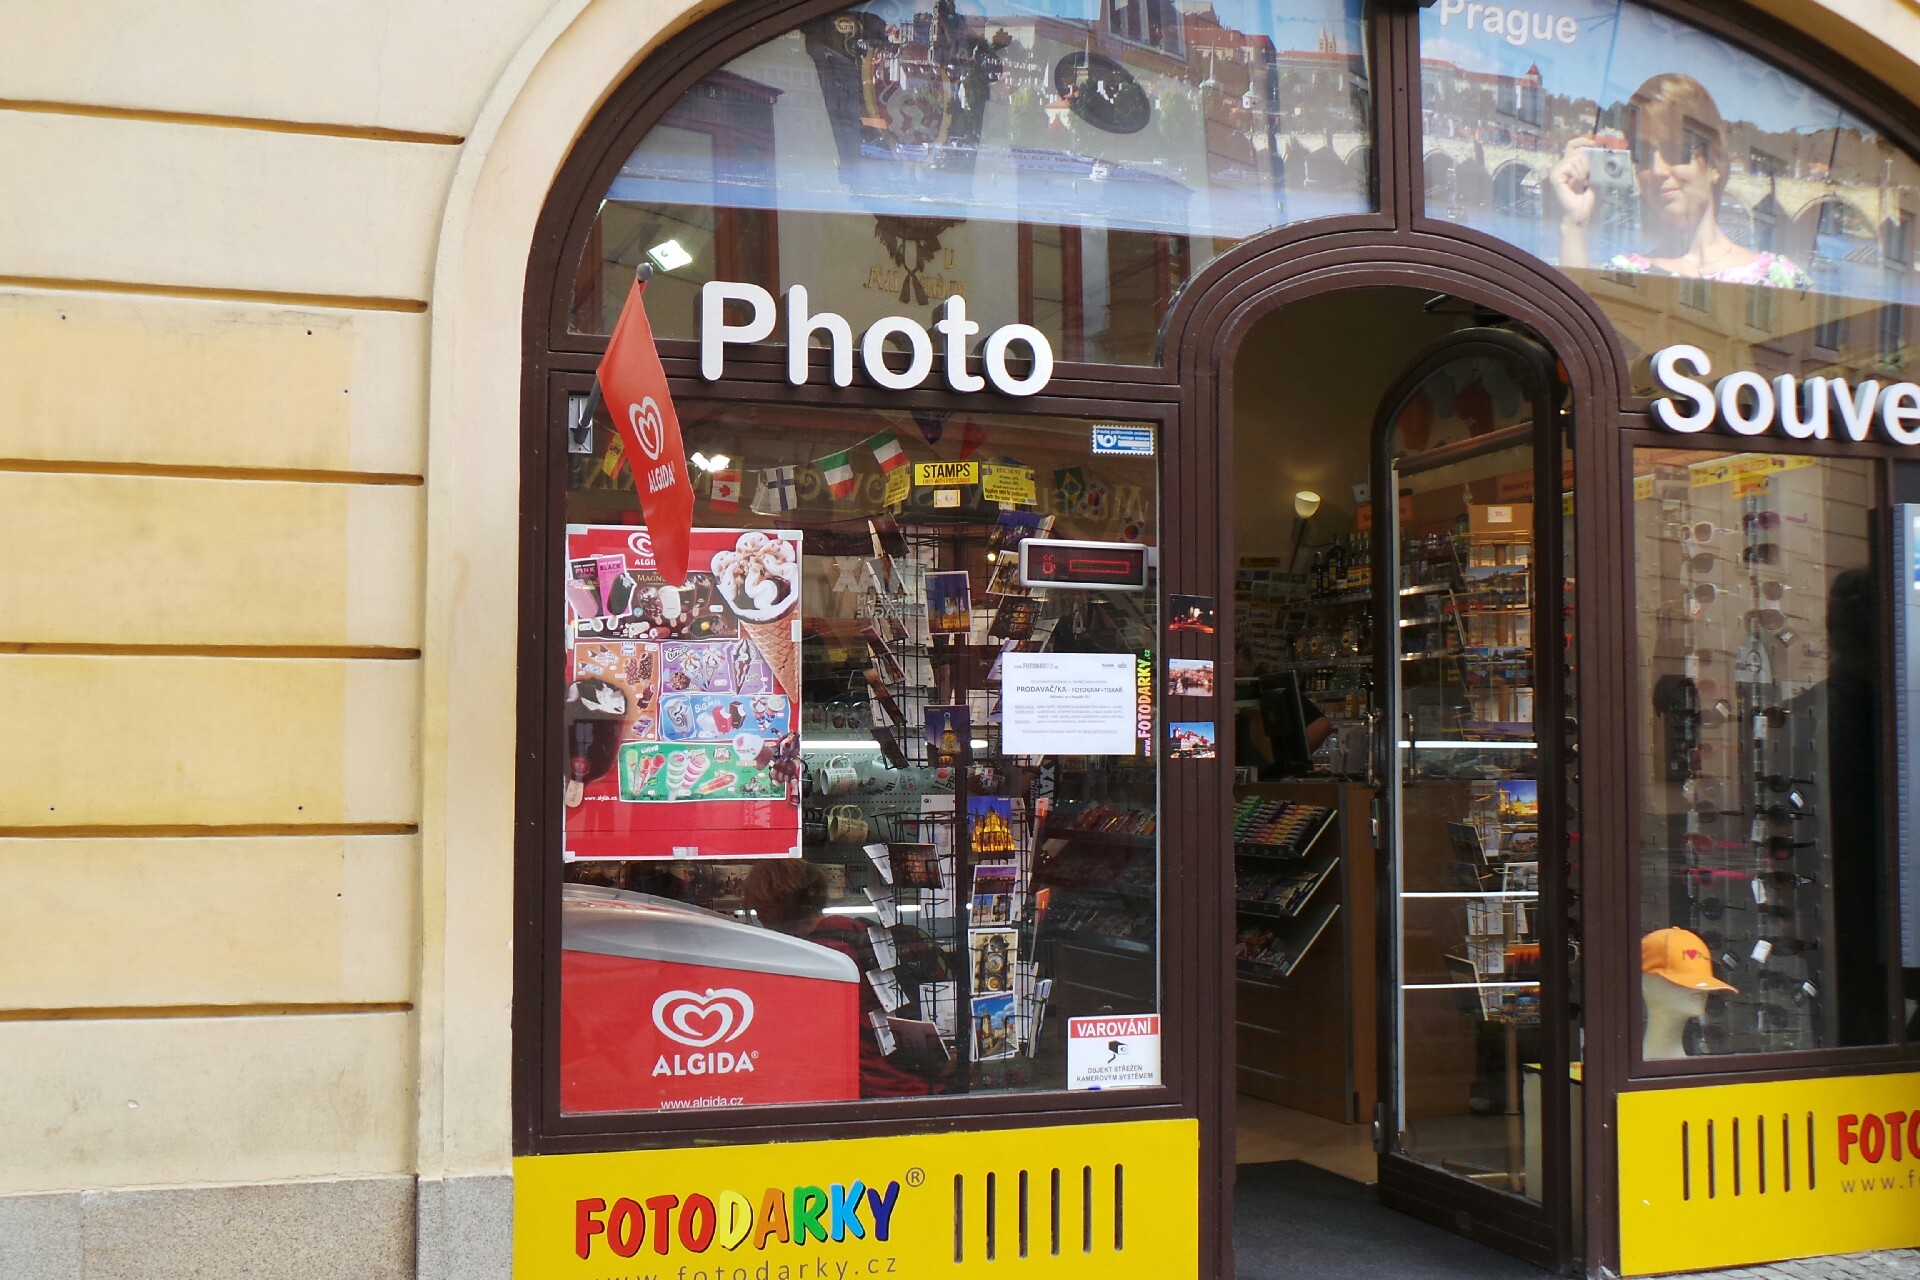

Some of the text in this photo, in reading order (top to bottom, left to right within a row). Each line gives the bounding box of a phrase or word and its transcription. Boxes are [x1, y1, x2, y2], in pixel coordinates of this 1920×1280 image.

[1440, 0, 1577, 46] Prague
[701, 280, 1054, 396] Photo
[1652, 344, 1920, 445] Souve
[648, 462, 675, 494] ALGIDA
[923, 463, 971, 479] STAMPS
[575, 566, 595, 574] PINK
[599, 563, 621, 571] BLACK
[637, 573, 665, 582] MAGN
[1016, 684, 1067, 694] PRODAVAČ/KA
[1137, 649, 1152, 757] www.FOTODARKY.cz
[1077, 1018, 1151, 1037] VAROVÁNÍ
[651, 1050, 755, 1078] ALGIDA
[1088, 1064, 1143, 1074] OBJEKT STŘEŽEN
[660, 1096, 744, 1109] www.algida.cz
[1841, 1169, 1920, 1193] www.f
[575, 1180, 901, 1260] FOTODARKY
